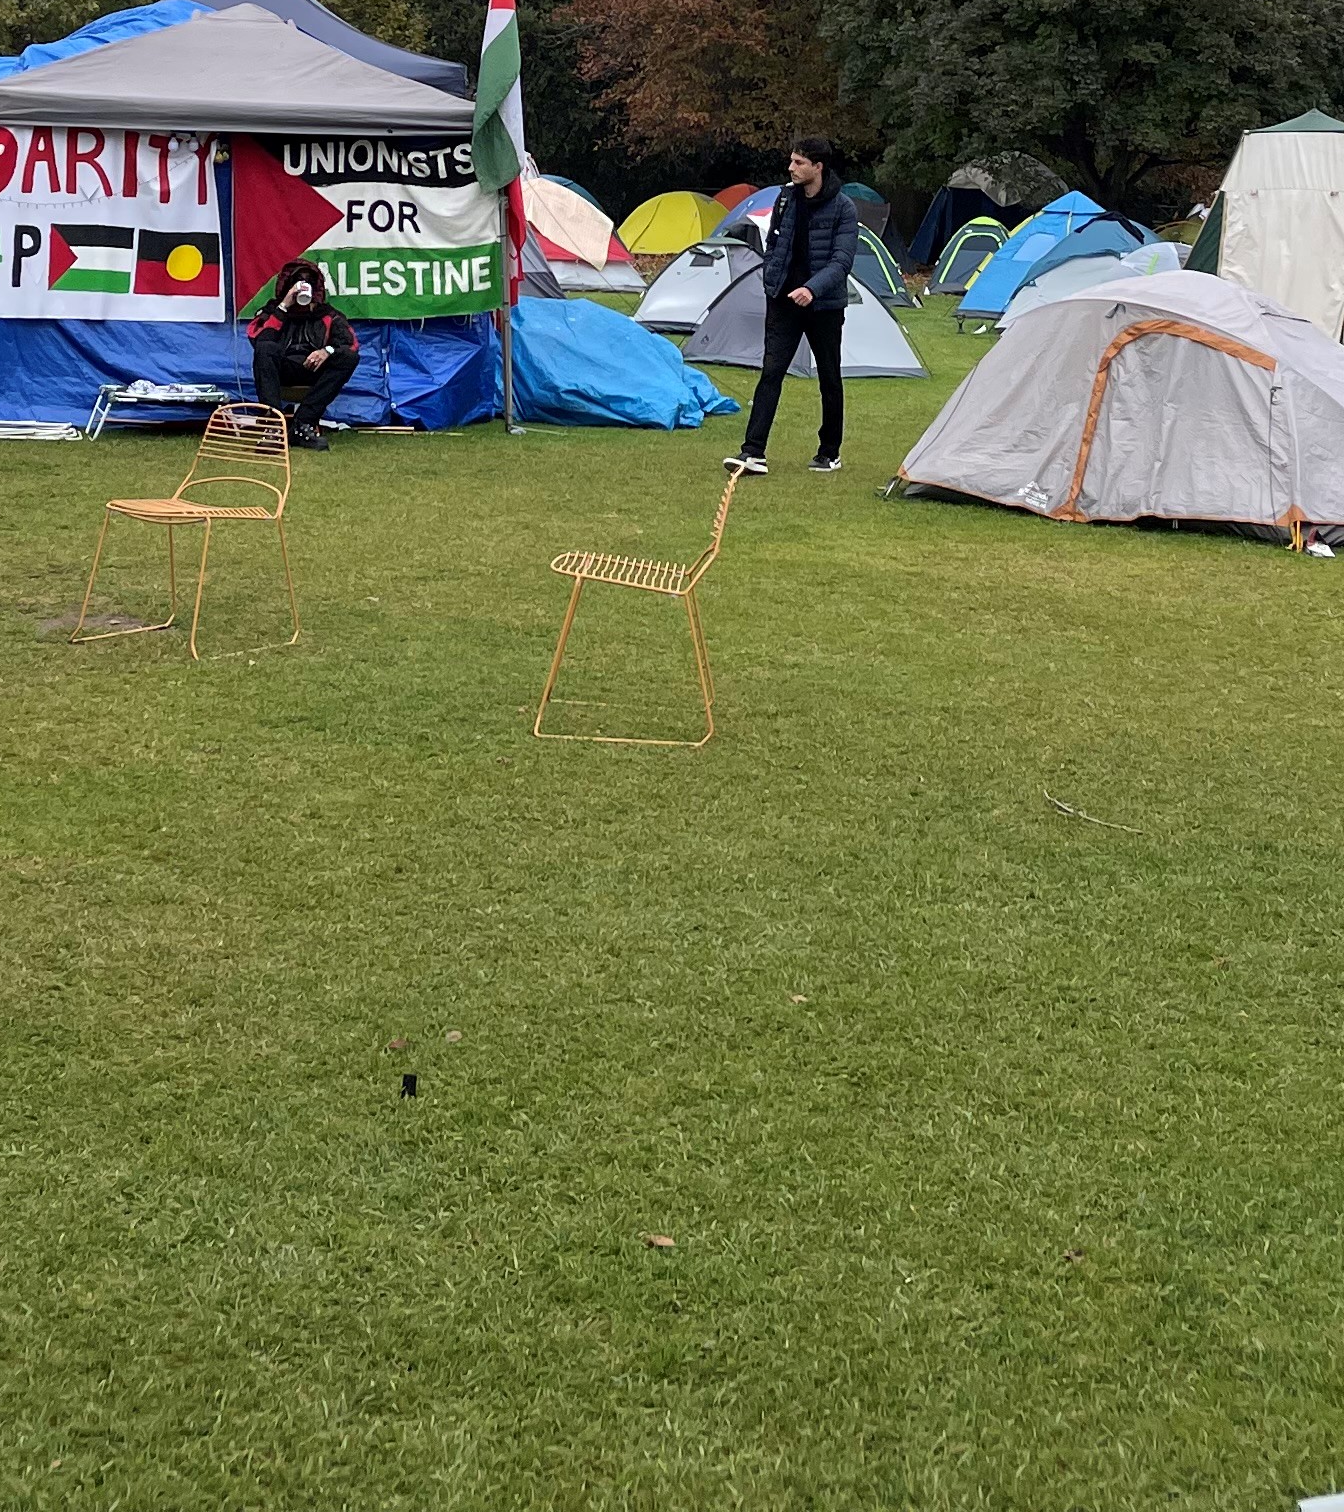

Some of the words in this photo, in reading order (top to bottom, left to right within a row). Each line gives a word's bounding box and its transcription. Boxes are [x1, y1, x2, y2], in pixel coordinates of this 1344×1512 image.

[283, 140, 474, 180] UNIONISTS
[346, 200, 420, 233] FOR
[318, 256, 491, 297] ALESTINE
